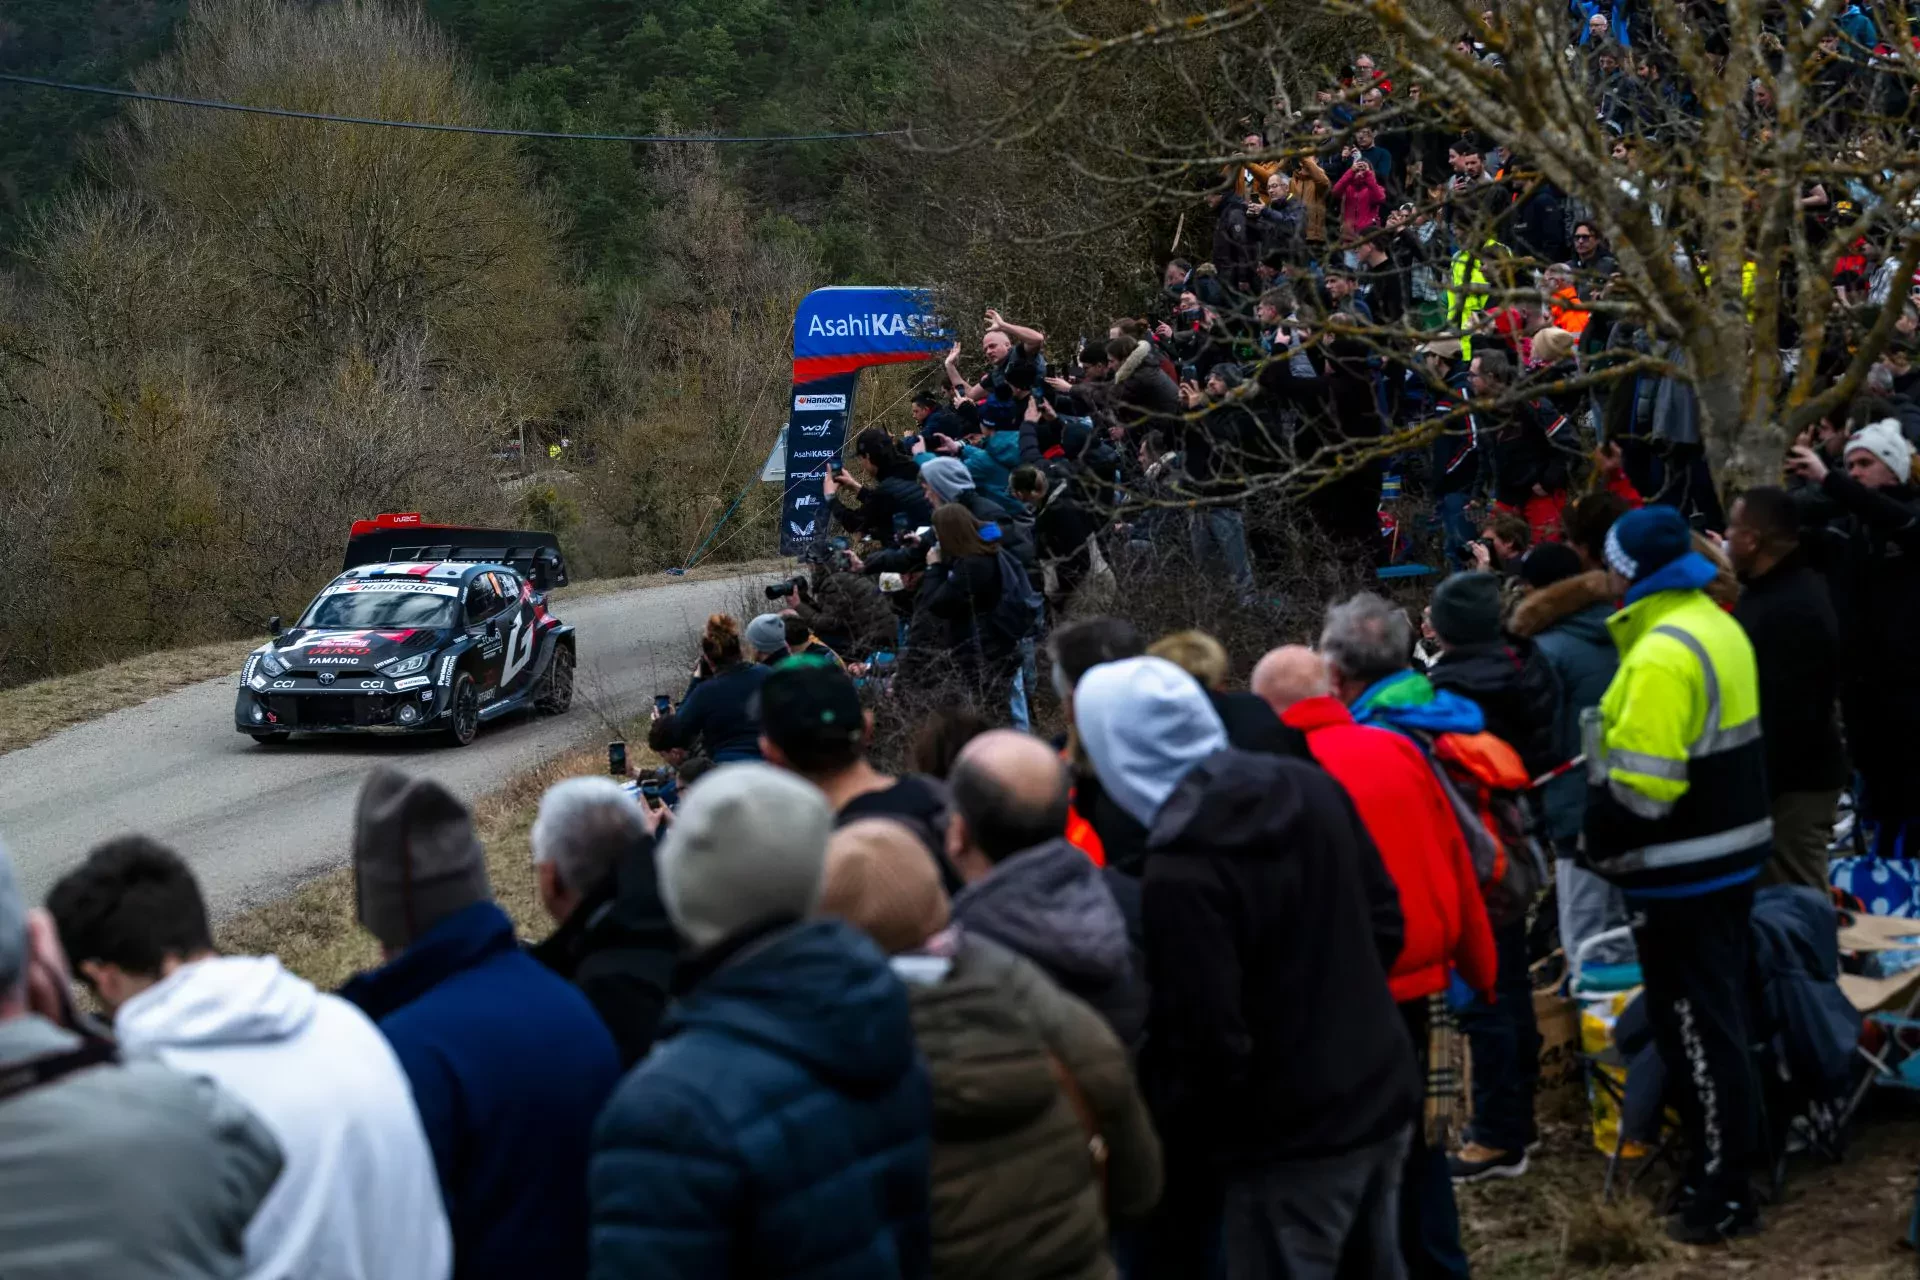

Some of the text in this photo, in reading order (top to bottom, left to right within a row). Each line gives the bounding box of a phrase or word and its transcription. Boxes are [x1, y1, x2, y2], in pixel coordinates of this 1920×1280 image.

[393, 515, 418, 523] WRC
[307, 647, 372, 655] DENSO
[273, 680, 296, 688] CCI
[361, 680, 384, 688] CCI
